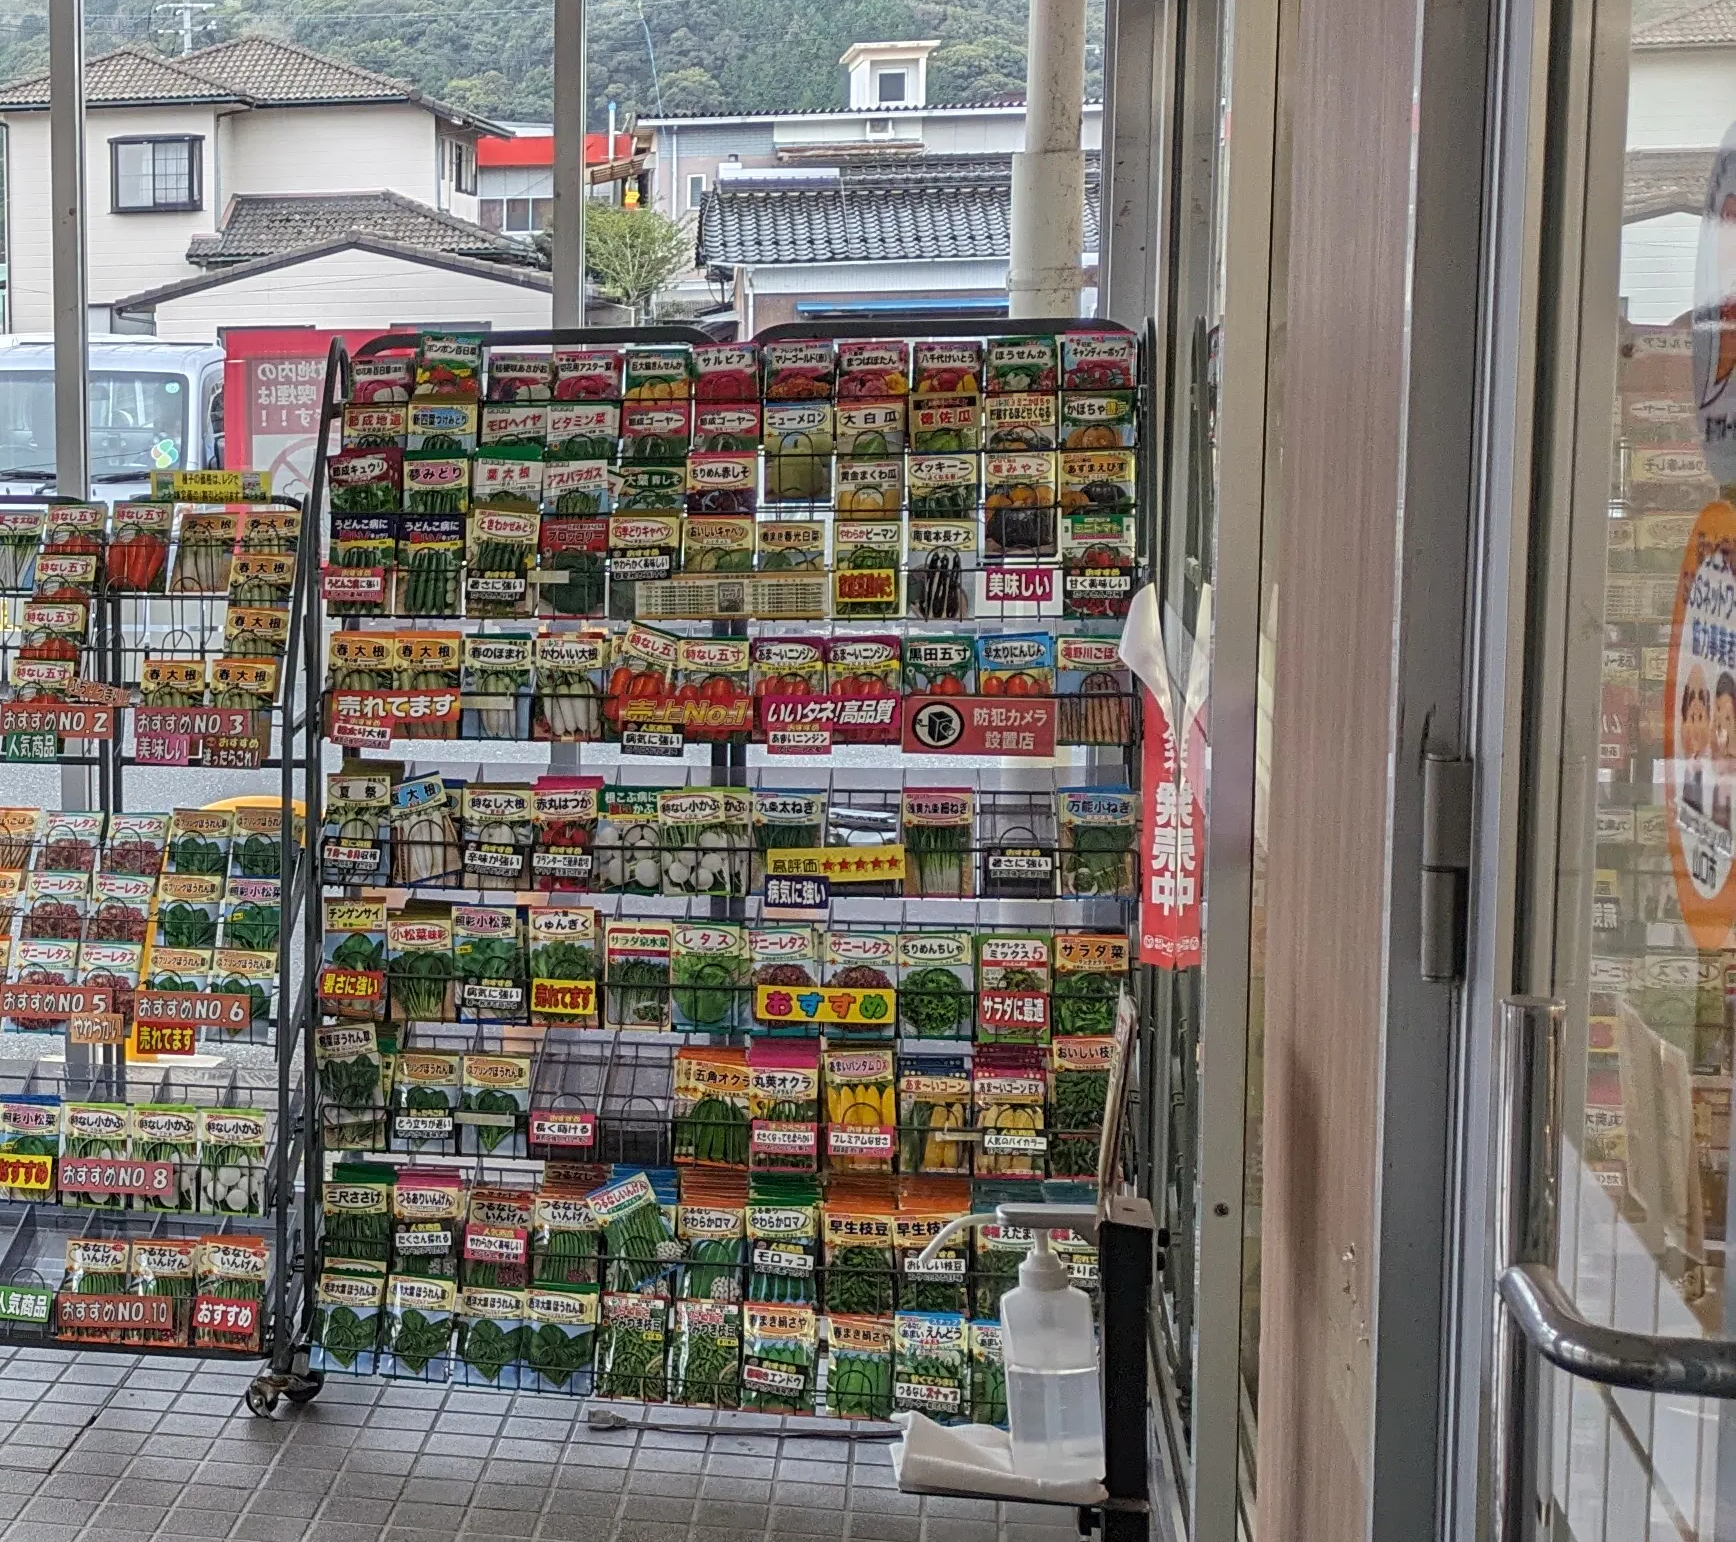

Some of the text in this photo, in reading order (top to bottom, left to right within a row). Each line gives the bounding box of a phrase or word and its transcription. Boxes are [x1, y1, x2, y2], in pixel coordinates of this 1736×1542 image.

[702, 354, 745, 365] サルビア
[995, 350, 1047, 360] ほうせんか
[487, 414, 542, 432] モロヘイヤ
[767, 414, 826, 426] ニューメロン
[843, 412, 898, 426] 大白瓜
[409, 465, 462, 480] 夢みどり
[913, 461, 970, 473] ズッキーニ
[840, 468, 897, 482] 黄金まくわ瓜
[469, 579, 524, 591] 暑さに強い
[989, 574, 1050, 597] 美味しい
[1068, 577, 1128, 589] 甘く美味しい
[337, 644, 385, 658] 春大根
[402, 645, 450, 658] 春大根
[471, 646, 526, 659] 春のほまれ
[541, 647, 598, 660] かわいい大根
[685, 648, 744, 662] 時なし五寸
[908, 647, 970, 662] 黒田五寸
[984, 645, 1046, 659] 早太りにんじん
[338, 693, 456, 717] 売れてます
[973, 707, 1048, 727] 防犯カメラ
[218, 737, 259, 748] おすすめ
[625, 733, 680, 746] 病気に強い
[771, 733, 828, 745] あまいニンジン
[985, 731, 1035, 750] 設置店
[7, 735, 56, 759] 人気商品
[138, 738, 188, 760] 美味しい
[471, 797, 525, 809] 時なし大根
[536, 797, 592, 810] 赤丸はつか
[757, 801, 815, 814] 九条太ねぎ
[1069, 800, 1132, 814] 万能小ねぎ
[47, 816, 100, 829] サニーレタス
[114, 819, 163, 831] サニーレタス
[467, 852, 520, 868] 辛味が強い
[772, 858, 819, 873] 高評価
[991, 858, 1049, 869] 暑さに強い
[32, 878, 85, 891] サニーレタス
[98, 882, 150, 894] サニーレタス
[767, 880, 826, 905] 病気に強い
[329, 907, 381, 920] チンゲンサイ
[533, 919, 590, 931] しゅんぎく
[682, 933, 729, 945] レタス
[749, 935, 808, 949] サニーレタス
[21, 947, 73, 960] サニーレタス
[831, 941, 892, 954] サニーレタス
[901, 941, 965, 955] ちりめんちしゃ
[1062, 945, 1125, 959] サラダ菜
[85, 951, 136, 963] サニーレタス
[323, 973, 378, 995] 暑さに強い
[467, 986, 520, 1000] 病気に強い
[535, 983, 592, 1010] 売れてます
[765, 991, 888, 1019] おすすめ
[983, 997, 1045, 1022] サラダに最適
[139, 1027, 194, 1053] 売れてます
[754, 1075, 812, 1089] 丸莢オクラ
[397, 1118, 452, 1130] とう立ちが遅い
[326, 1191, 381, 1204] 三尺ささげ
[398, 1192, 452, 1204] つるありいんげん
[476, 1202, 516, 1212] つるなし
[541, 1201, 579, 1209] つるなし
[829, 1220, 889, 1236] 早生枝豆
[72, 1243, 112, 1255] つるなし
[137, 1246, 178, 1259] つるなし
[211, 1244, 252, 1258] つるなし
[81, 1252, 121, 1265] いんげん
[147, 1255, 187, 1269] いんげん
[220, 1256, 261, 1272] いんげん
[906, 1260, 963, 1272] おいしい枝豆
[197, 1301, 253, 1329] おすすめ
[926, 1327, 962, 1341] えんどう
